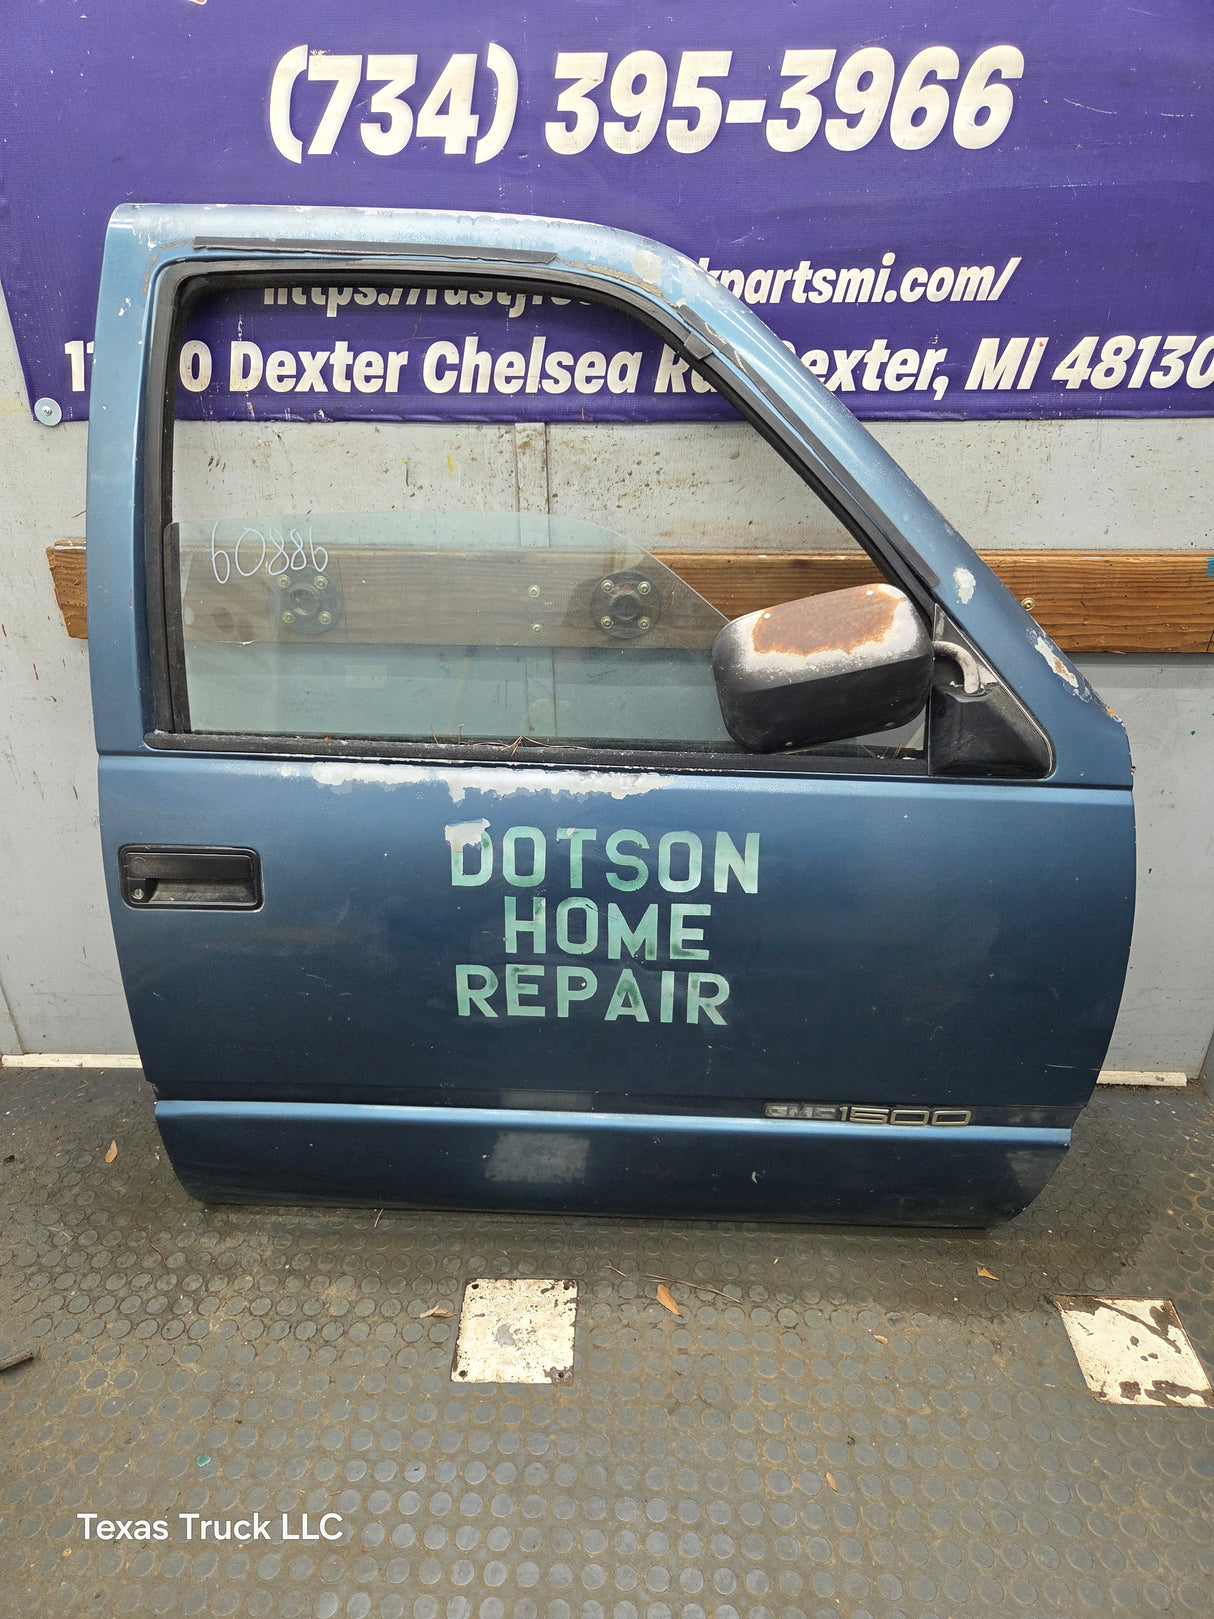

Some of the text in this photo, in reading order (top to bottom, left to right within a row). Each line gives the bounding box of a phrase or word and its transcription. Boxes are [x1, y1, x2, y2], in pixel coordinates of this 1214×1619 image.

[269, 43, 1025, 165] (734) 395-3966
[229, 340, 408, 393] Dexter
[422, 335, 642, 394] Chelsea
[781, 338, 949, 401] exter,
[964, 336, 1050, 390] MI
[211, 520, 328, 584] 60886
[446, 820, 760, 894] DOTSON
[503, 895, 712, 961] HOME
[455, 963, 731, 1026] REPAIR
